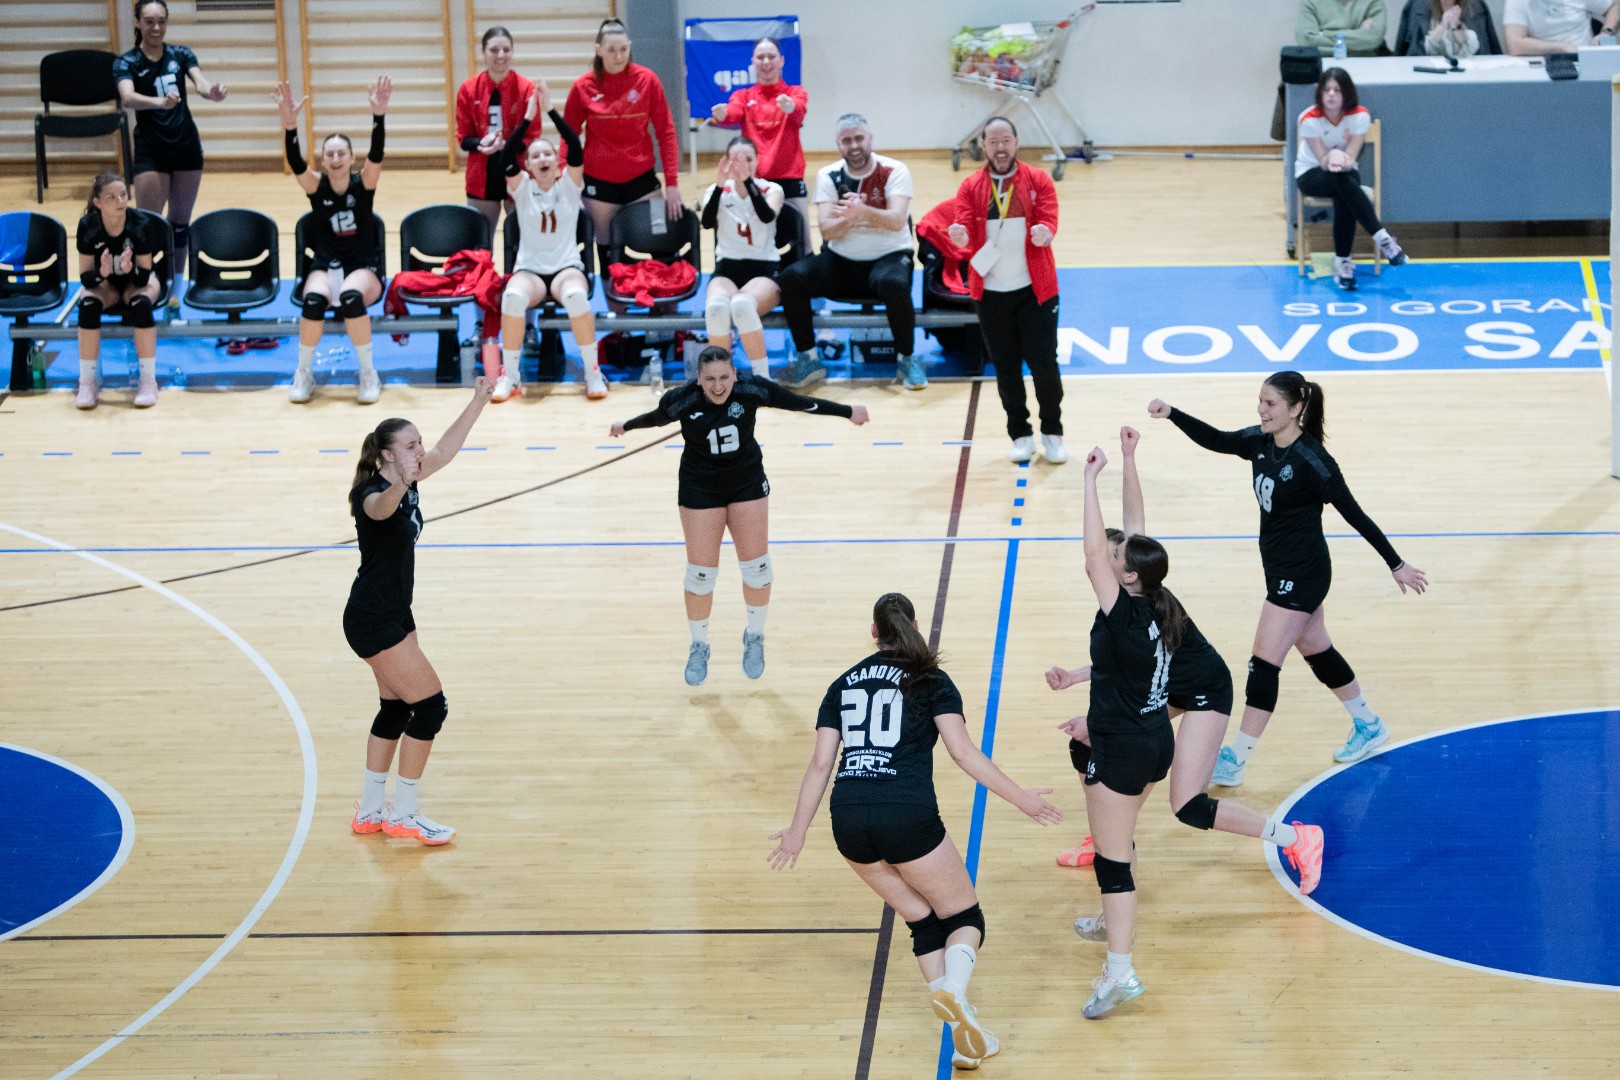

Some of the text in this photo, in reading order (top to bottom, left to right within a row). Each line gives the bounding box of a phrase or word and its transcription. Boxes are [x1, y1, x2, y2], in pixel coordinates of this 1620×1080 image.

[153, 73, 179, 98] 15
[714, 64, 758, 92] gal
[330, 209, 357, 234] 12
[541, 210, 557, 233] 11
[737, 223, 753, 246] 4
[1283, 302, 1368, 317] SD
[1056, 320, 1419, 365] NOVO
[706, 424, 740, 455] 13
[1255, 473, 1275, 513] 18
[1279, 579, 1294, 592] 18
[846, 665, 910, 686] ISANOVI
[841, 688, 903, 747] 20
